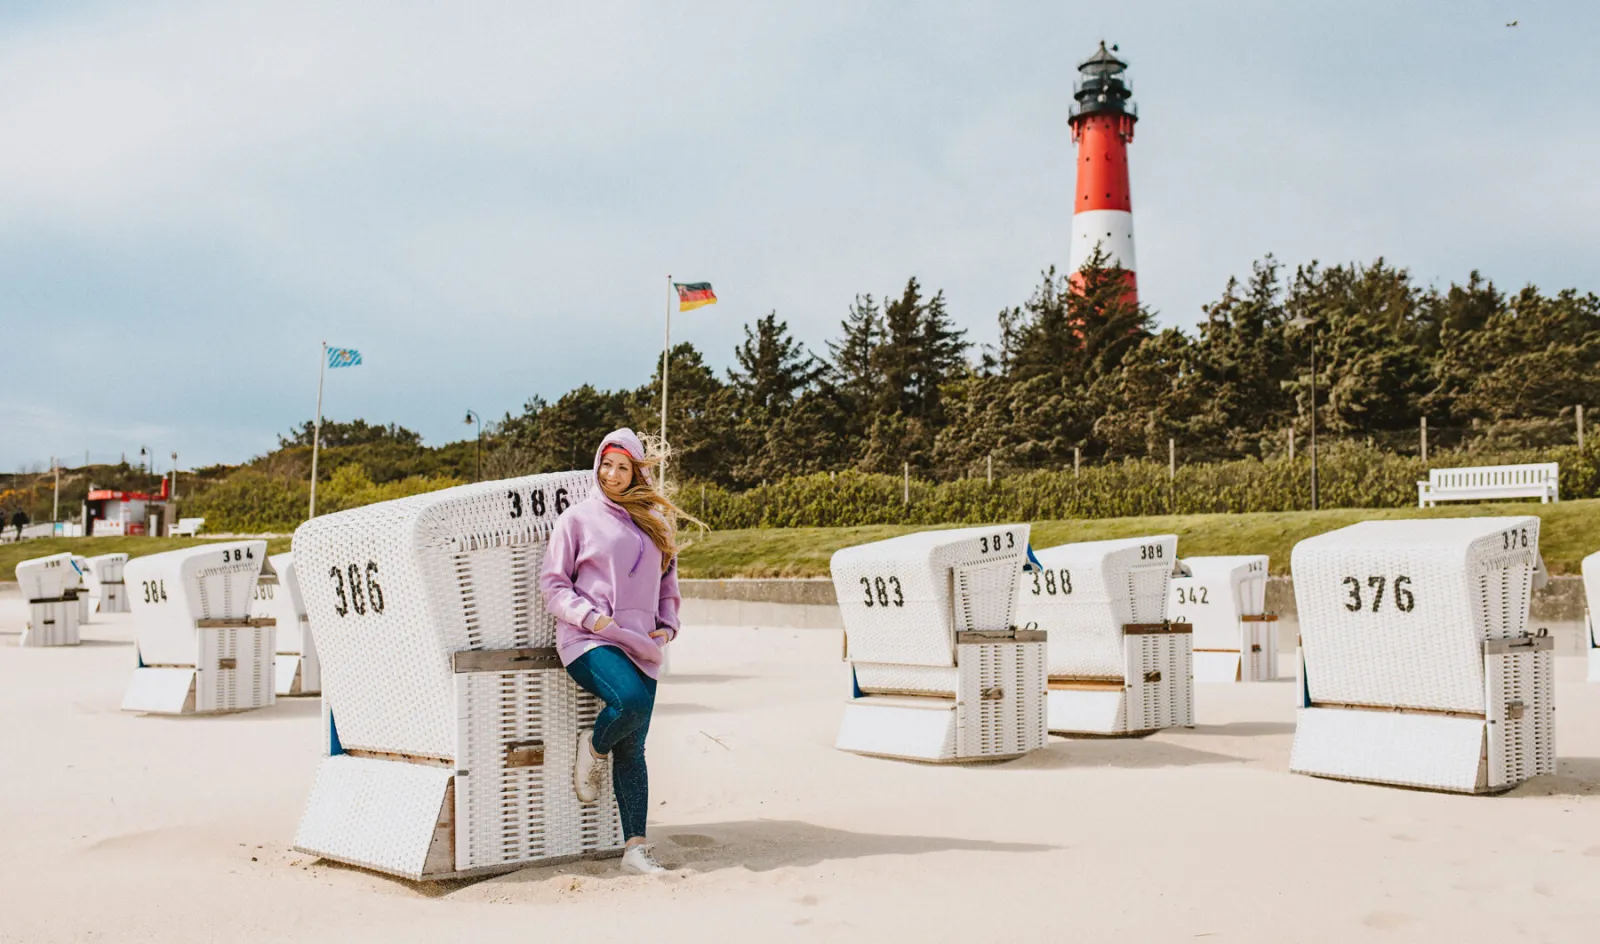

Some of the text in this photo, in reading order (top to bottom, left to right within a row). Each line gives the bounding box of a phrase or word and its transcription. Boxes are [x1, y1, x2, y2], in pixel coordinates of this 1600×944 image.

[508, 488, 570, 518] 386
[980, 532, 1015, 553] 383
[1503, 529, 1527, 549] 376
[223, 548, 253, 562] 384
[1141, 545, 1162, 559] 388
[143, 580, 167, 603] 384
[330, 561, 384, 617] 386
[860, 576, 904, 607] 383
[1030, 568, 1072, 595] 388
[1177, 587, 1208, 604] 342
[1344, 576, 1414, 612] 376
